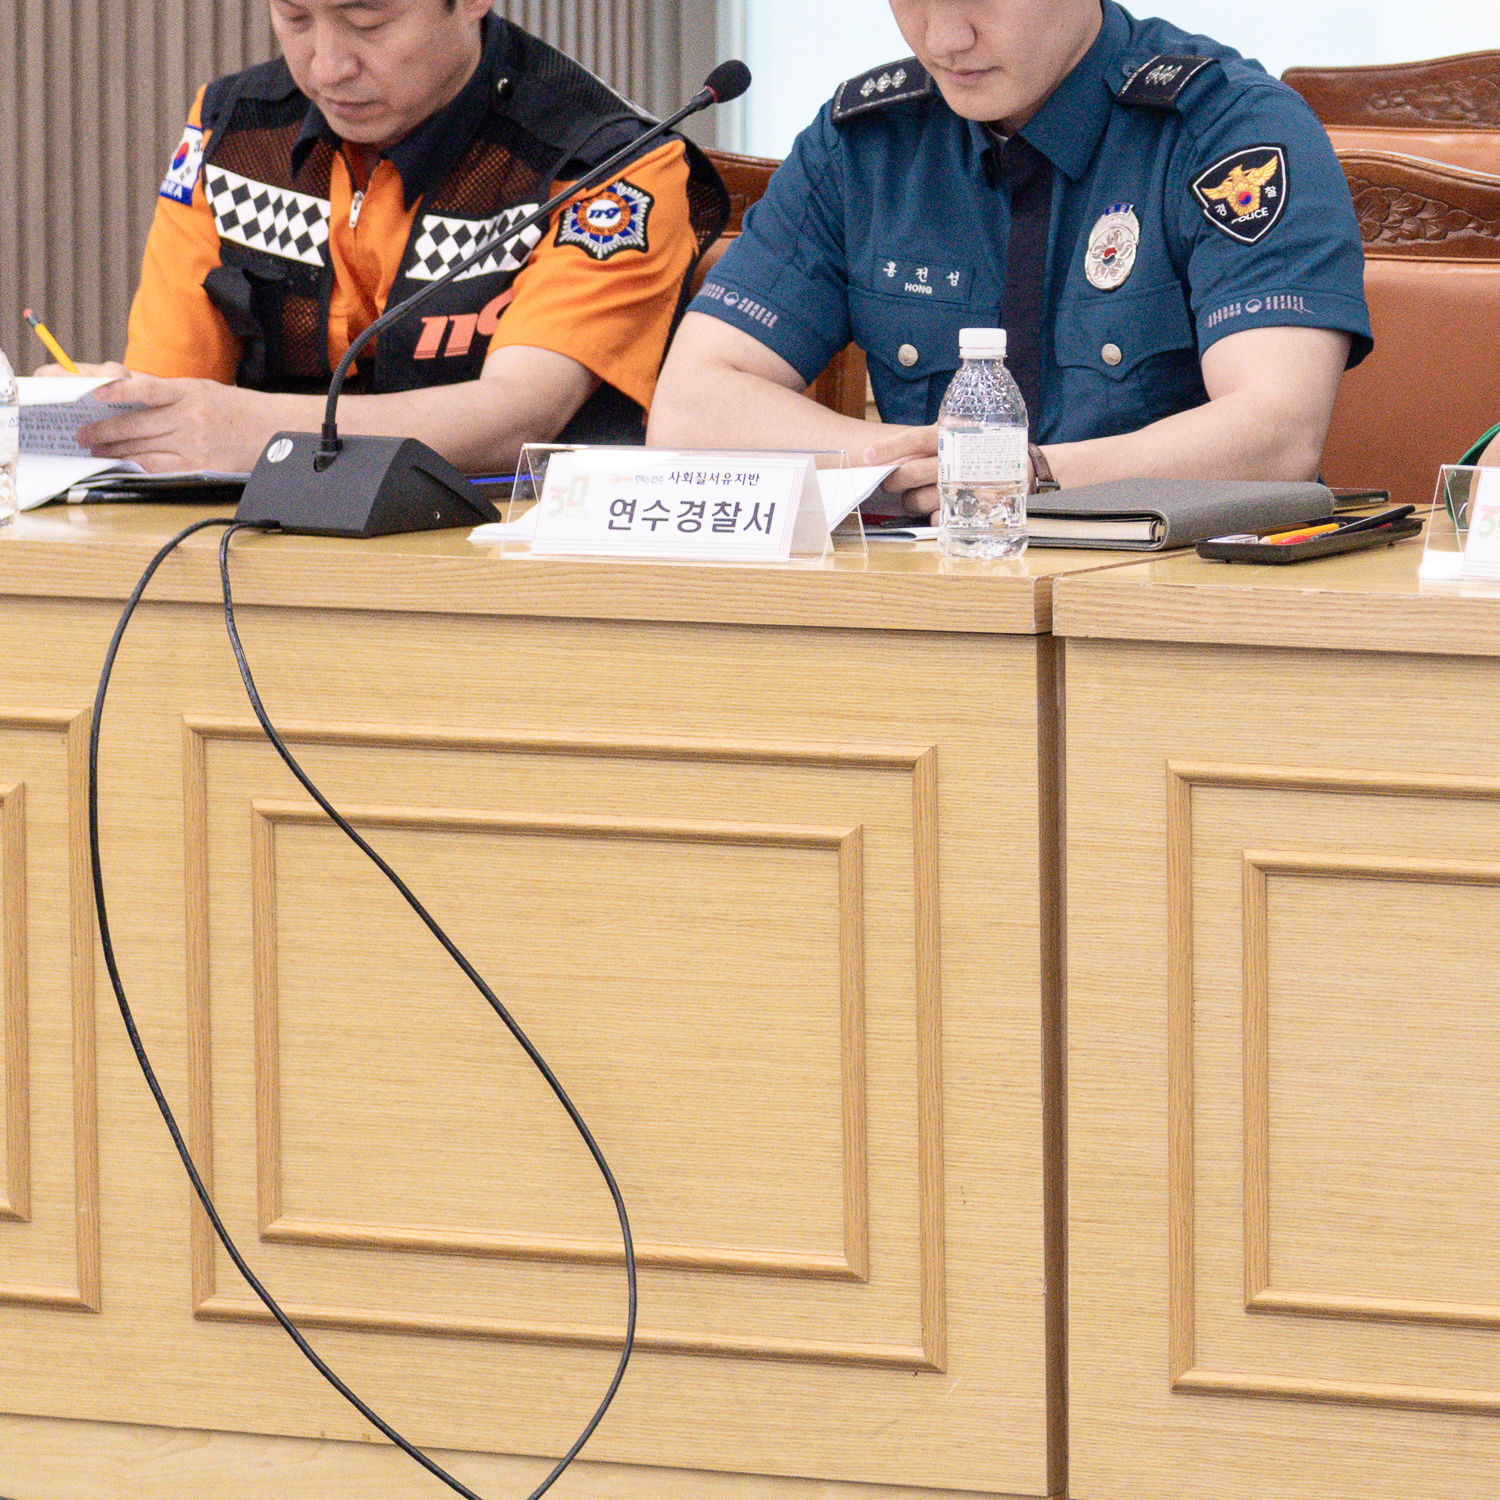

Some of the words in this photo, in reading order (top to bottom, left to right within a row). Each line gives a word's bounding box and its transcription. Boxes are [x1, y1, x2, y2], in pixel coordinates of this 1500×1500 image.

[905, 283, 932, 294] HONG
[668, 471, 760, 486] 사회질서유지반
[607, 498, 776, 534] 연수경찰서
